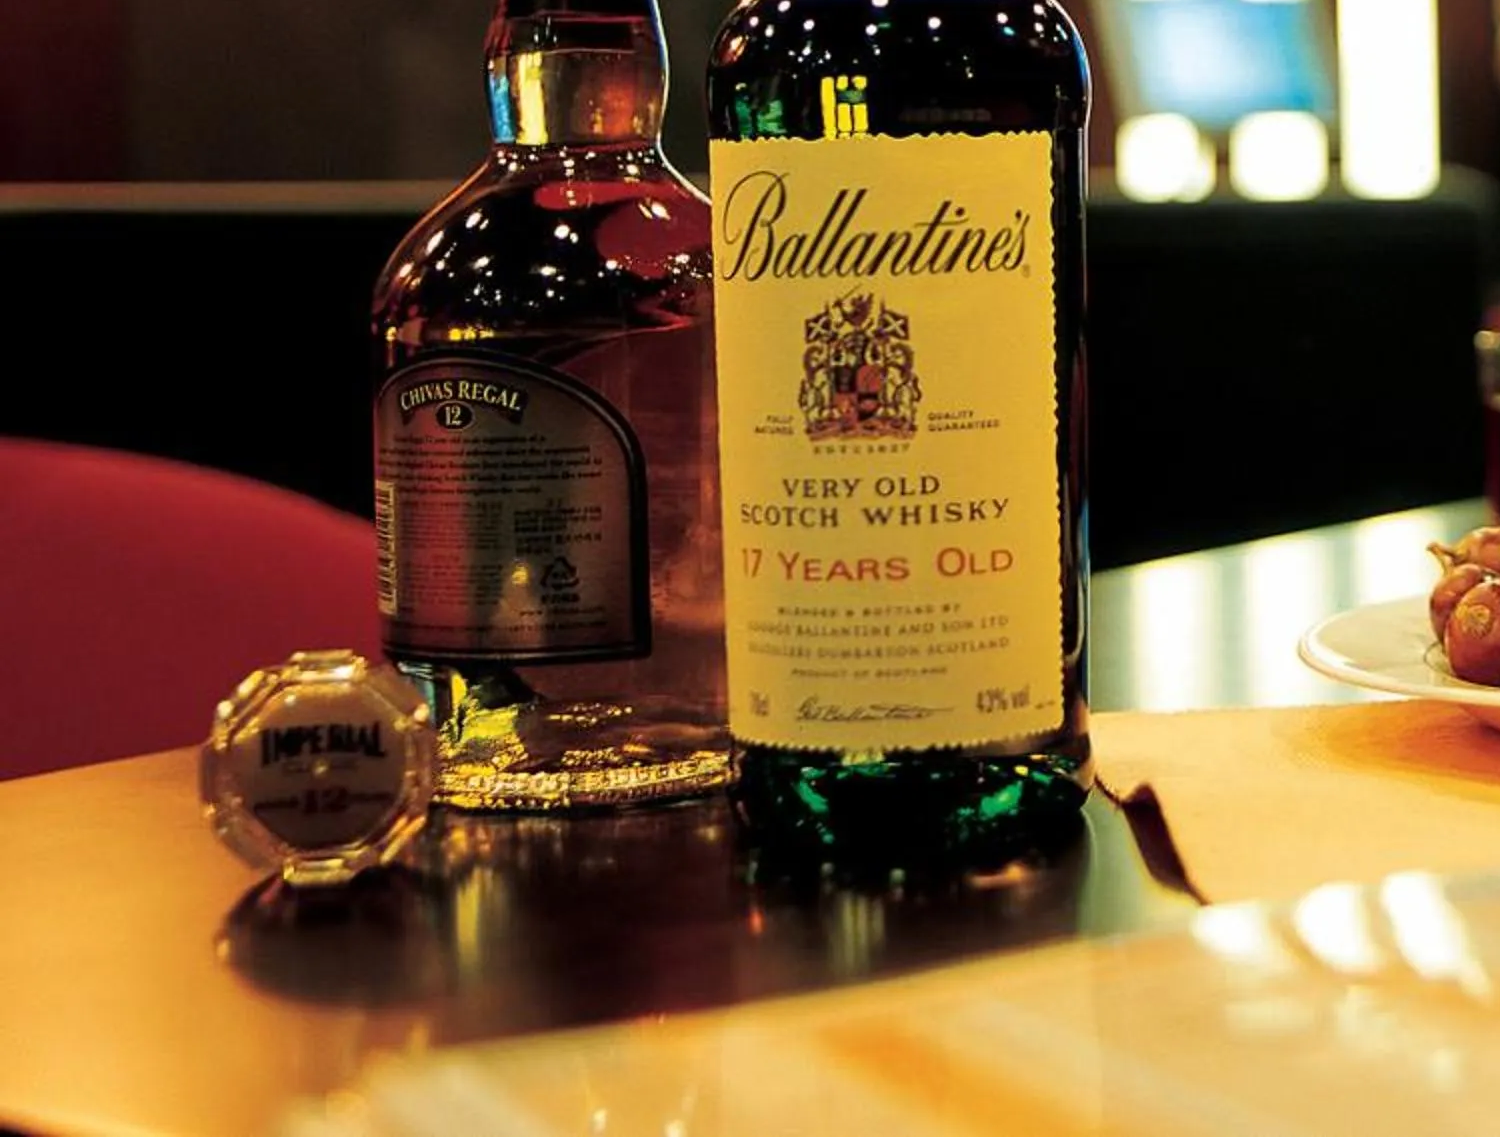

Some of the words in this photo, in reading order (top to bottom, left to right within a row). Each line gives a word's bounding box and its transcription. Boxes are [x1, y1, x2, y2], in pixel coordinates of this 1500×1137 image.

[722, 170, 1030, 282] Ballantine's
[401, 381, 453, 411] CHIVAS
[458, 380, 520, 411] REGAL
[445, 404, 462, 426] 12
[928, 410, 974, 421] QUALITY
[782, 478, 861, 498] VERY
[874, 475, 941, 496] OLD
[741, 503, 839, 529] SCOTCH
[863, 498, 1009, 526] WHISKY
[742, 549, 763, 578] 17
[777, 551, 910, 582] YEARS
[936, 547, 1014, 577] OLD
[899, 622, 936, 635] AND
[982, 614, 1009, 629] LTD
[927, 636, 1010, 656] SCOTLAND
[259, 721, 388, 768] IMPERIAL
